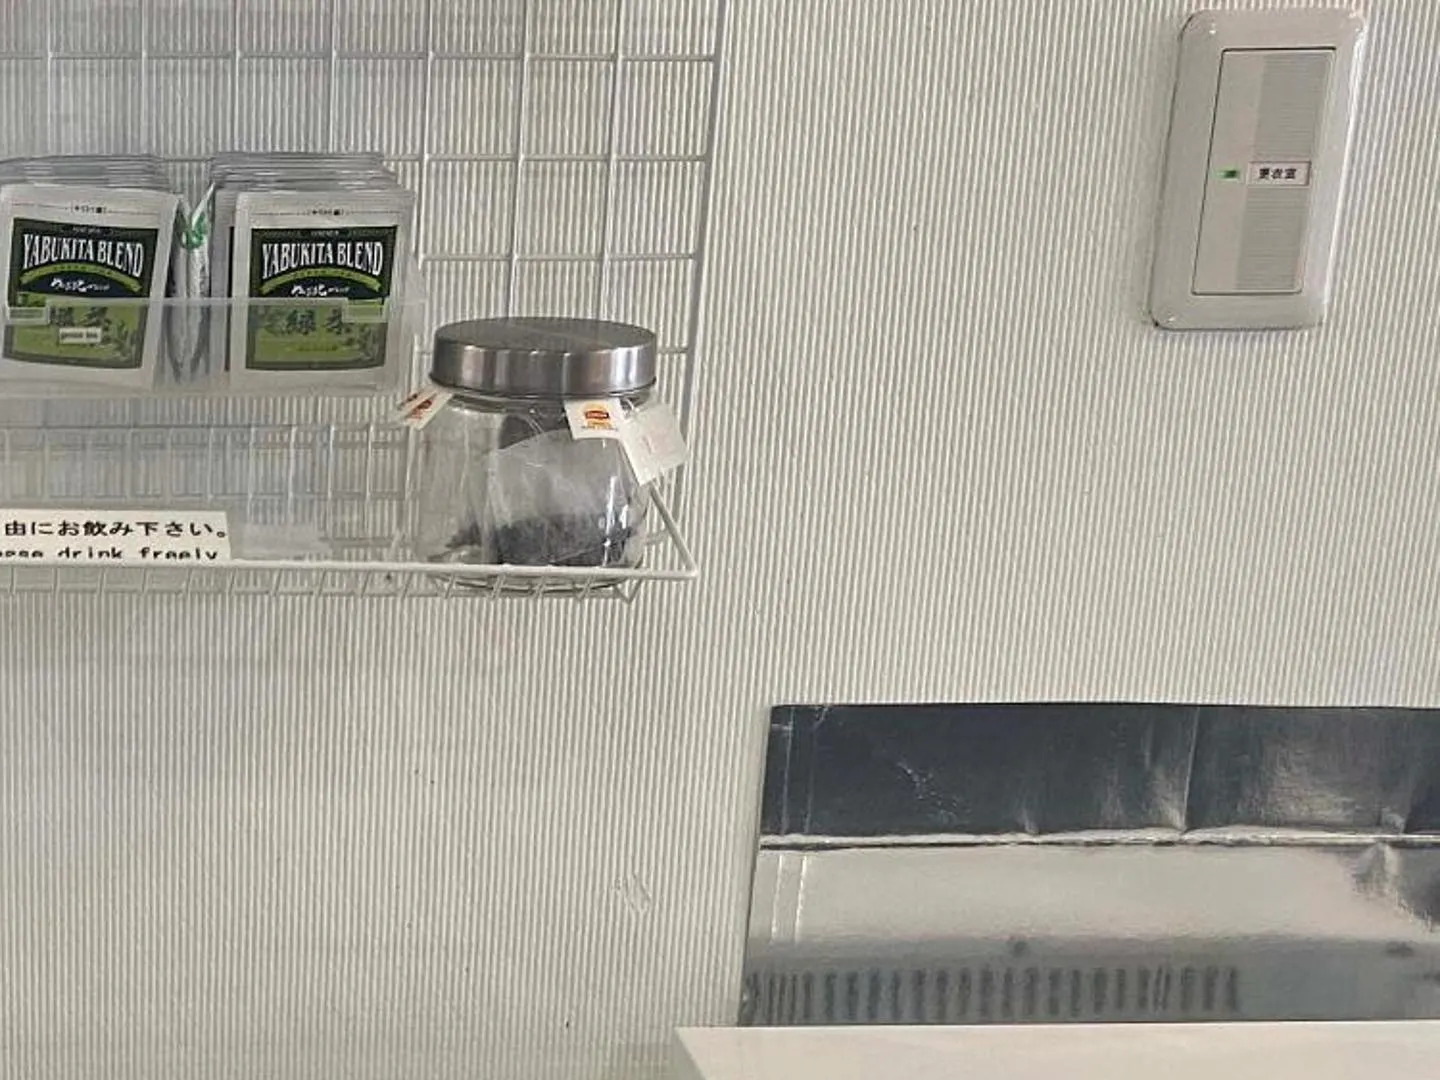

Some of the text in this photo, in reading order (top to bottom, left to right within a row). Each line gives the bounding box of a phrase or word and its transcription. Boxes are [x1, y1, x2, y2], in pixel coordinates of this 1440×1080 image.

[1258, 168, 1296, 179] 更衣室
[24, 234, 144, 278] YABUKITA BLEND
[262, 241, 383, 279] YABUKITA BLEND
[58, 546, 122, 559] drink
